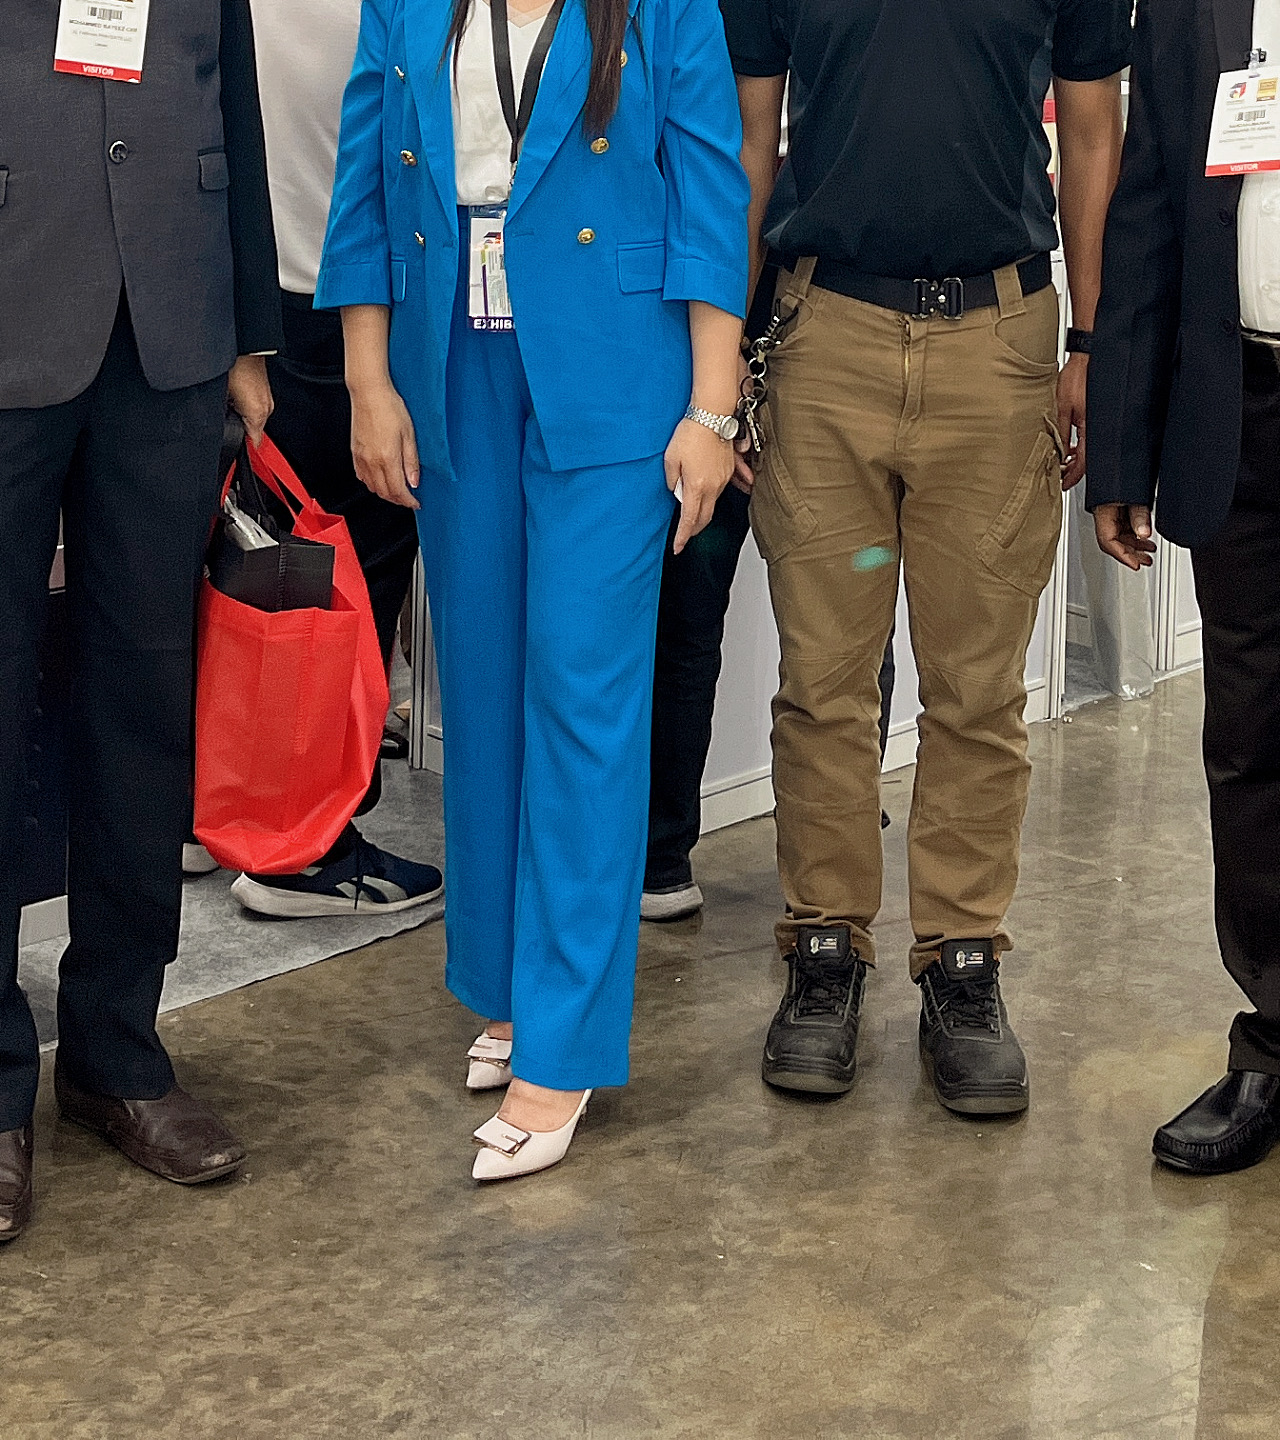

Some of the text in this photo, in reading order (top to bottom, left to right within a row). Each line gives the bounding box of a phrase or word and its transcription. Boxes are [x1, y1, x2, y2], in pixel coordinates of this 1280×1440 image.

[82, 64, 114, 76] VISITOR
[1229, 162, 1259, 172] VISITOR
[473, 318, 514, 330] EXHIB
